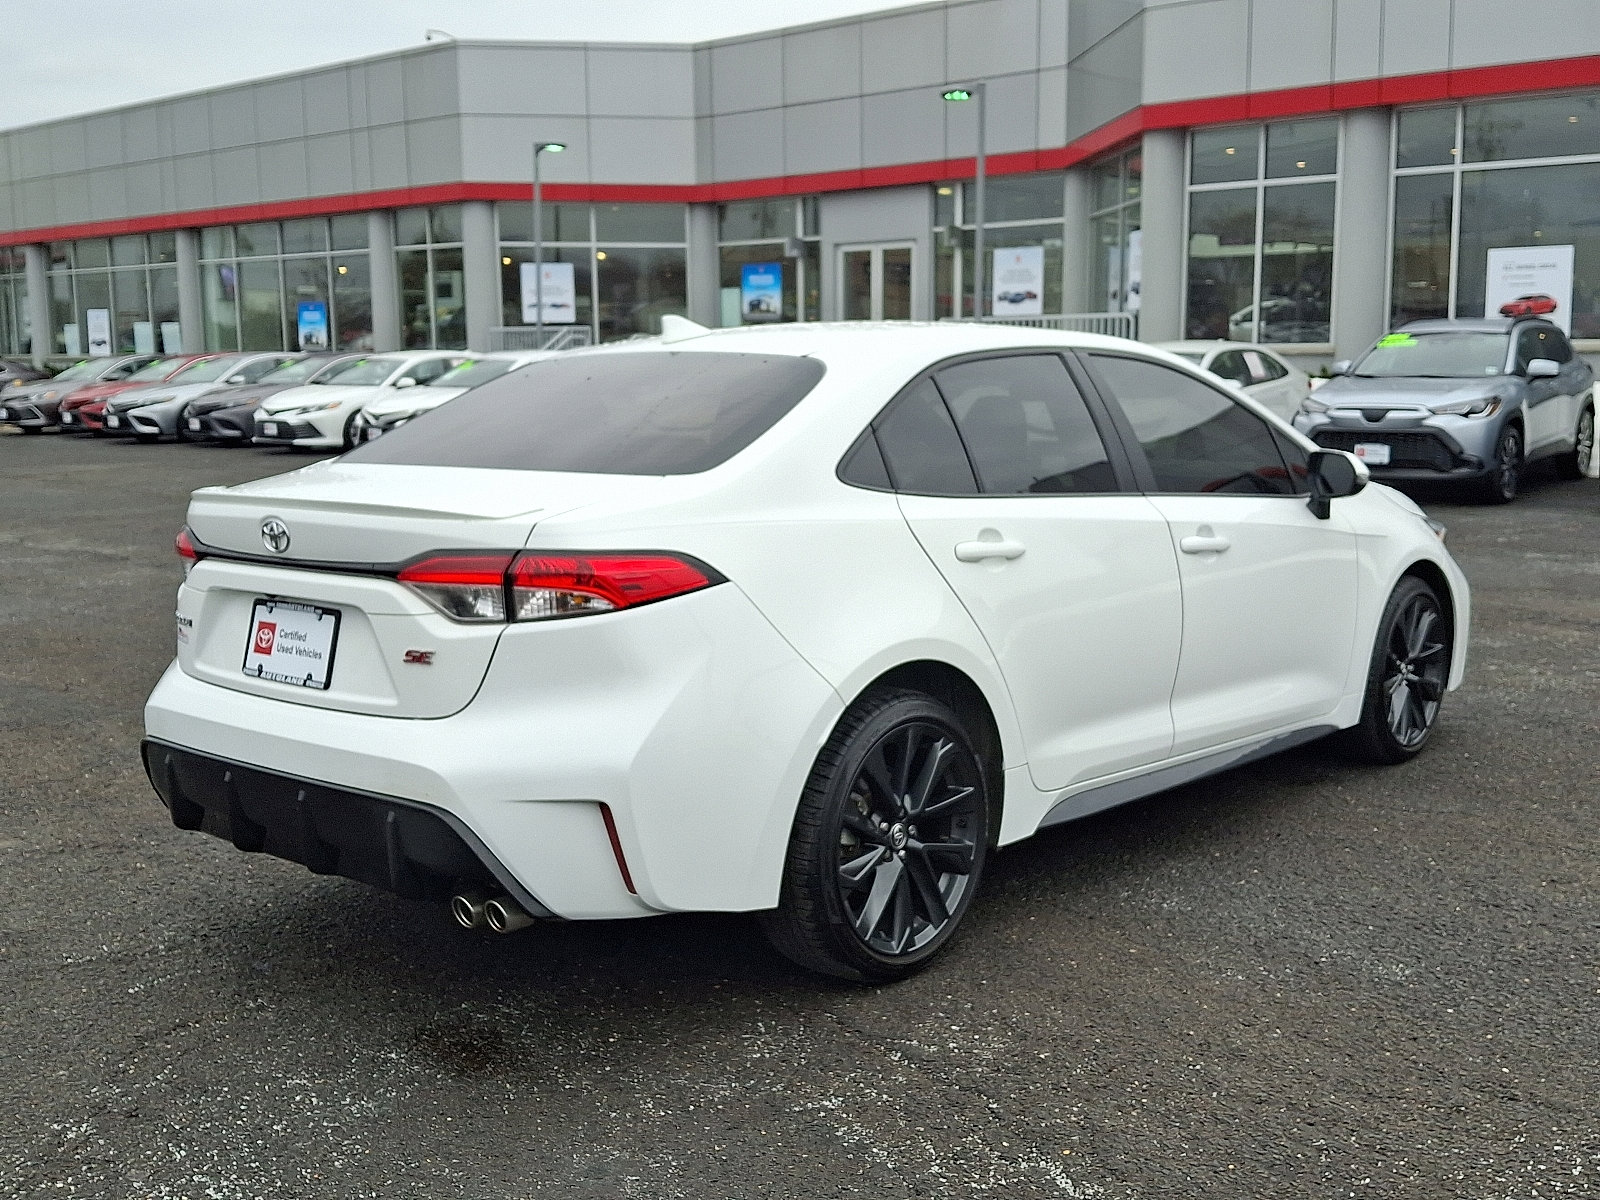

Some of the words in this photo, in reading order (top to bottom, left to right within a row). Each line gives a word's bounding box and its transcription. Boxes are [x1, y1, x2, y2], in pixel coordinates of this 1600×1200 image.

[279, 628, 307, 642] Certified
[276, 641, 294, 655] Used
[295, 645, 322, 660] Vehicles
[402, 649, 436, 665] SE
